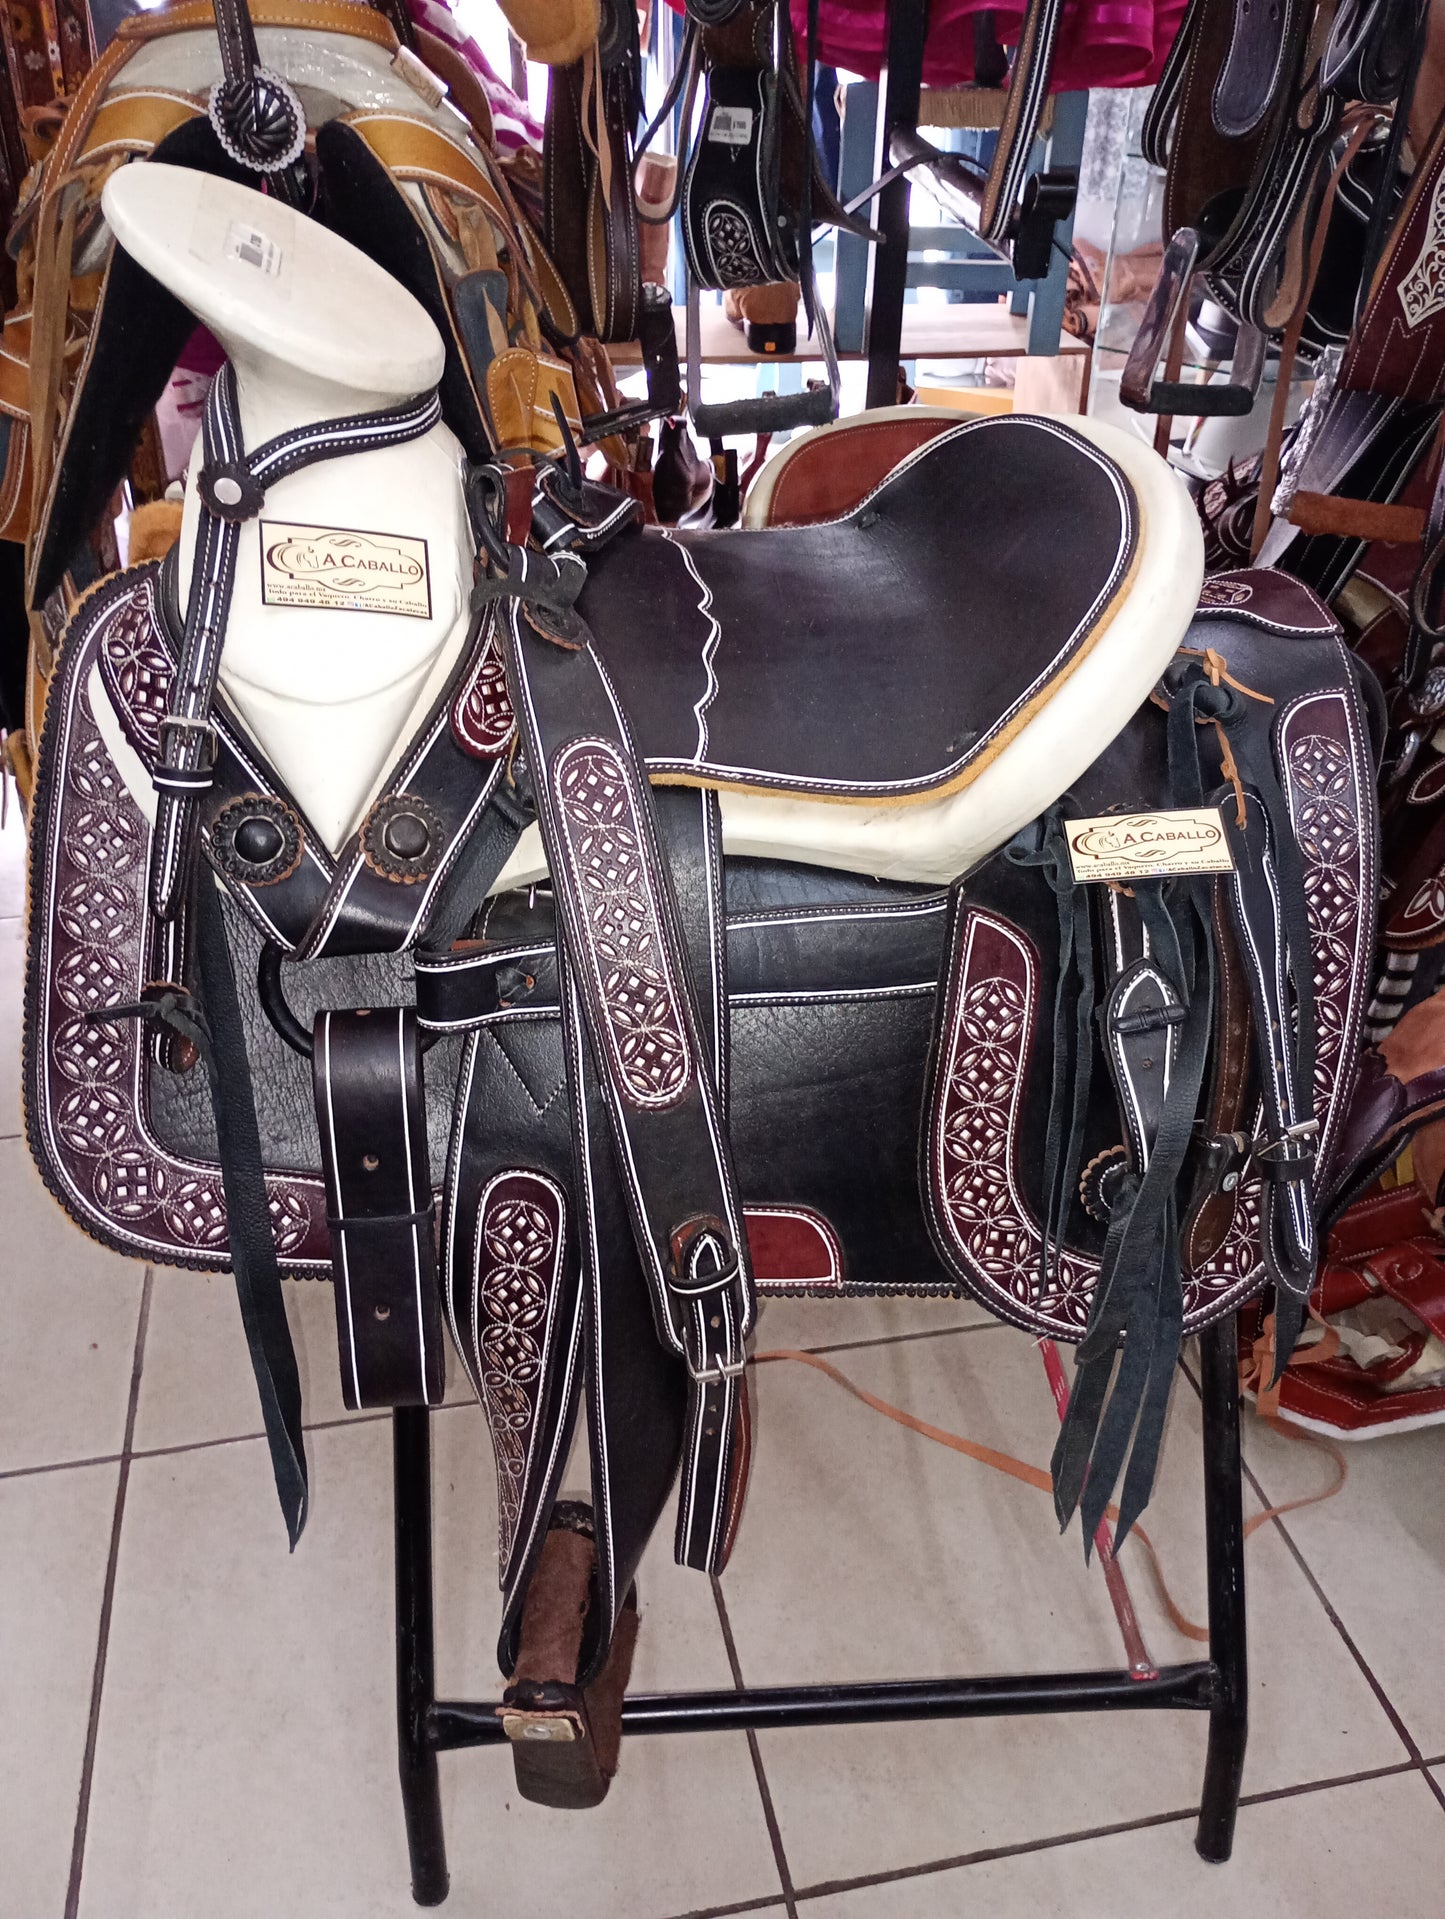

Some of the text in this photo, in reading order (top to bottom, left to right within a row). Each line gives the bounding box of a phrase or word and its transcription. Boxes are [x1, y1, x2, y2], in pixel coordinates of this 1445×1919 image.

[323, 553, 420, 576] A CABALLO
[1123, 829, 1216, 844] A CABALLO
